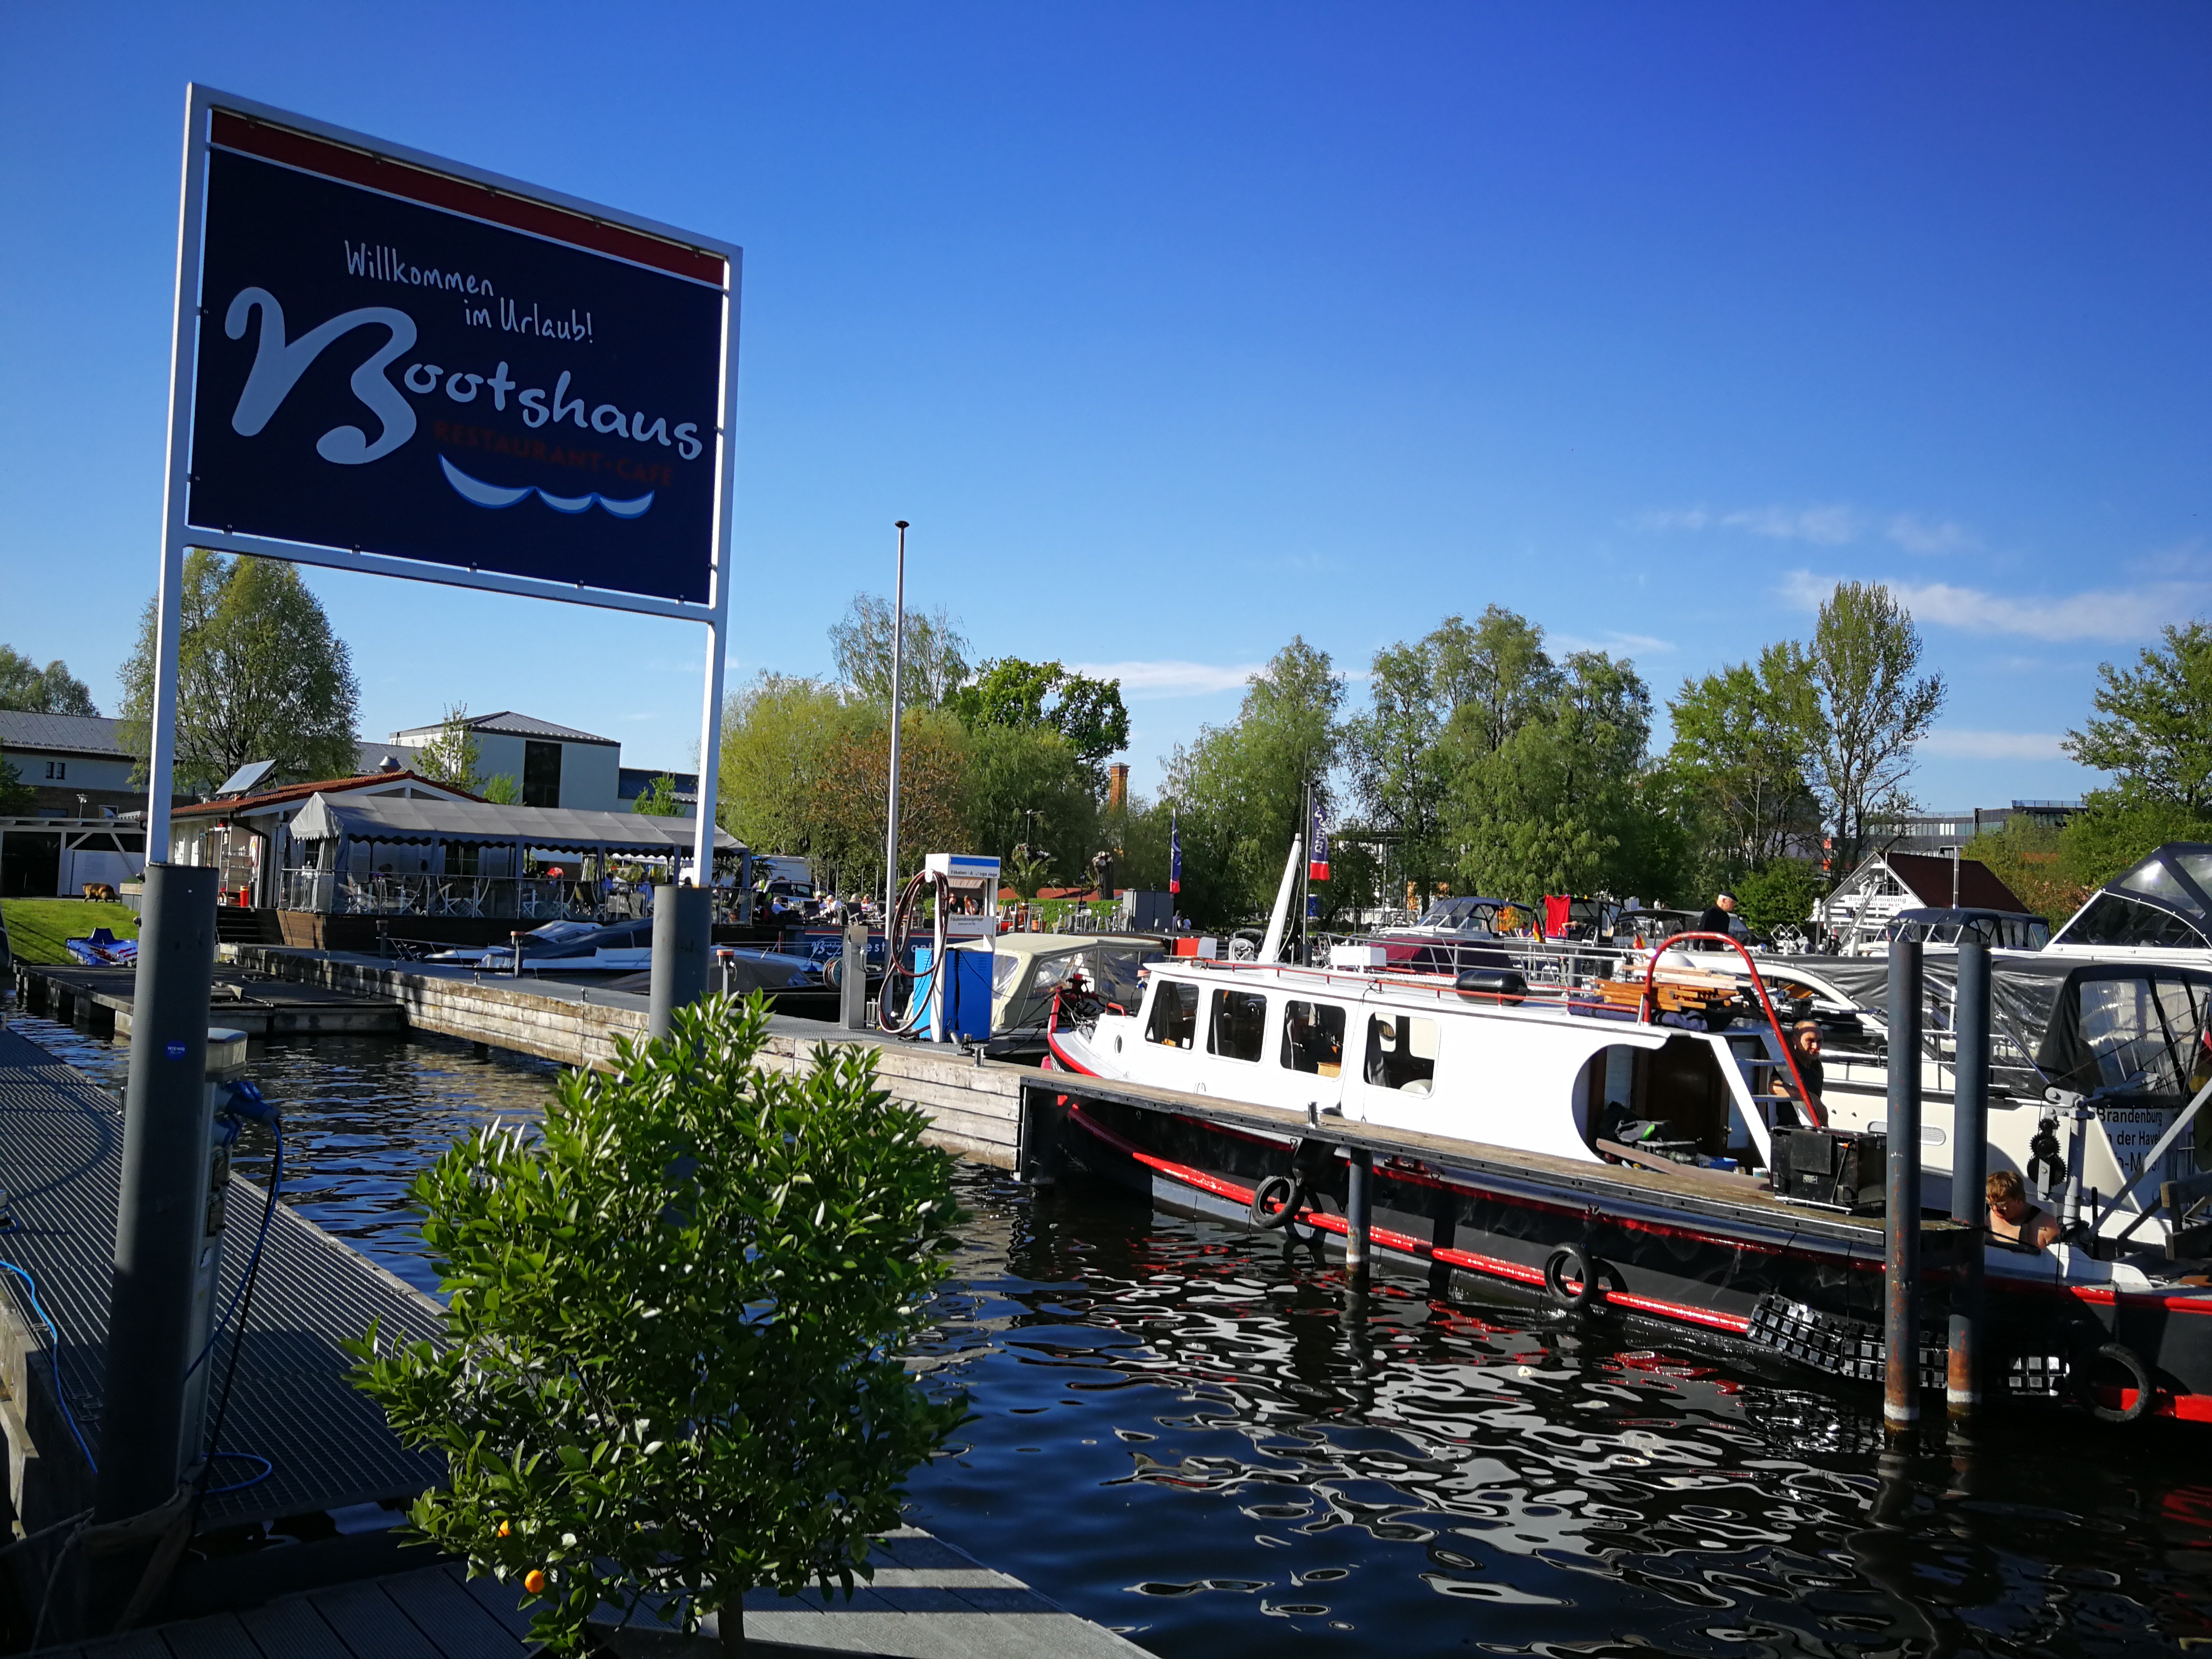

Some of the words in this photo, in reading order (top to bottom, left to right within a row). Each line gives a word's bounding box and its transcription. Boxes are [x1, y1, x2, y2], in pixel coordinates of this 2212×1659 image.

[344, 239, 494, 297] Willkommen
[463, 299, 492, 328] im
[500, 297, 593, 343] Urlaub!
[225, 287, 702, 465] Bootshaus
[2096, 1107, 2162, 1127] Brandenburg
[2117, 1130, 2136, 1146] der
[2138, 1130, 2161, 1146] Havel
